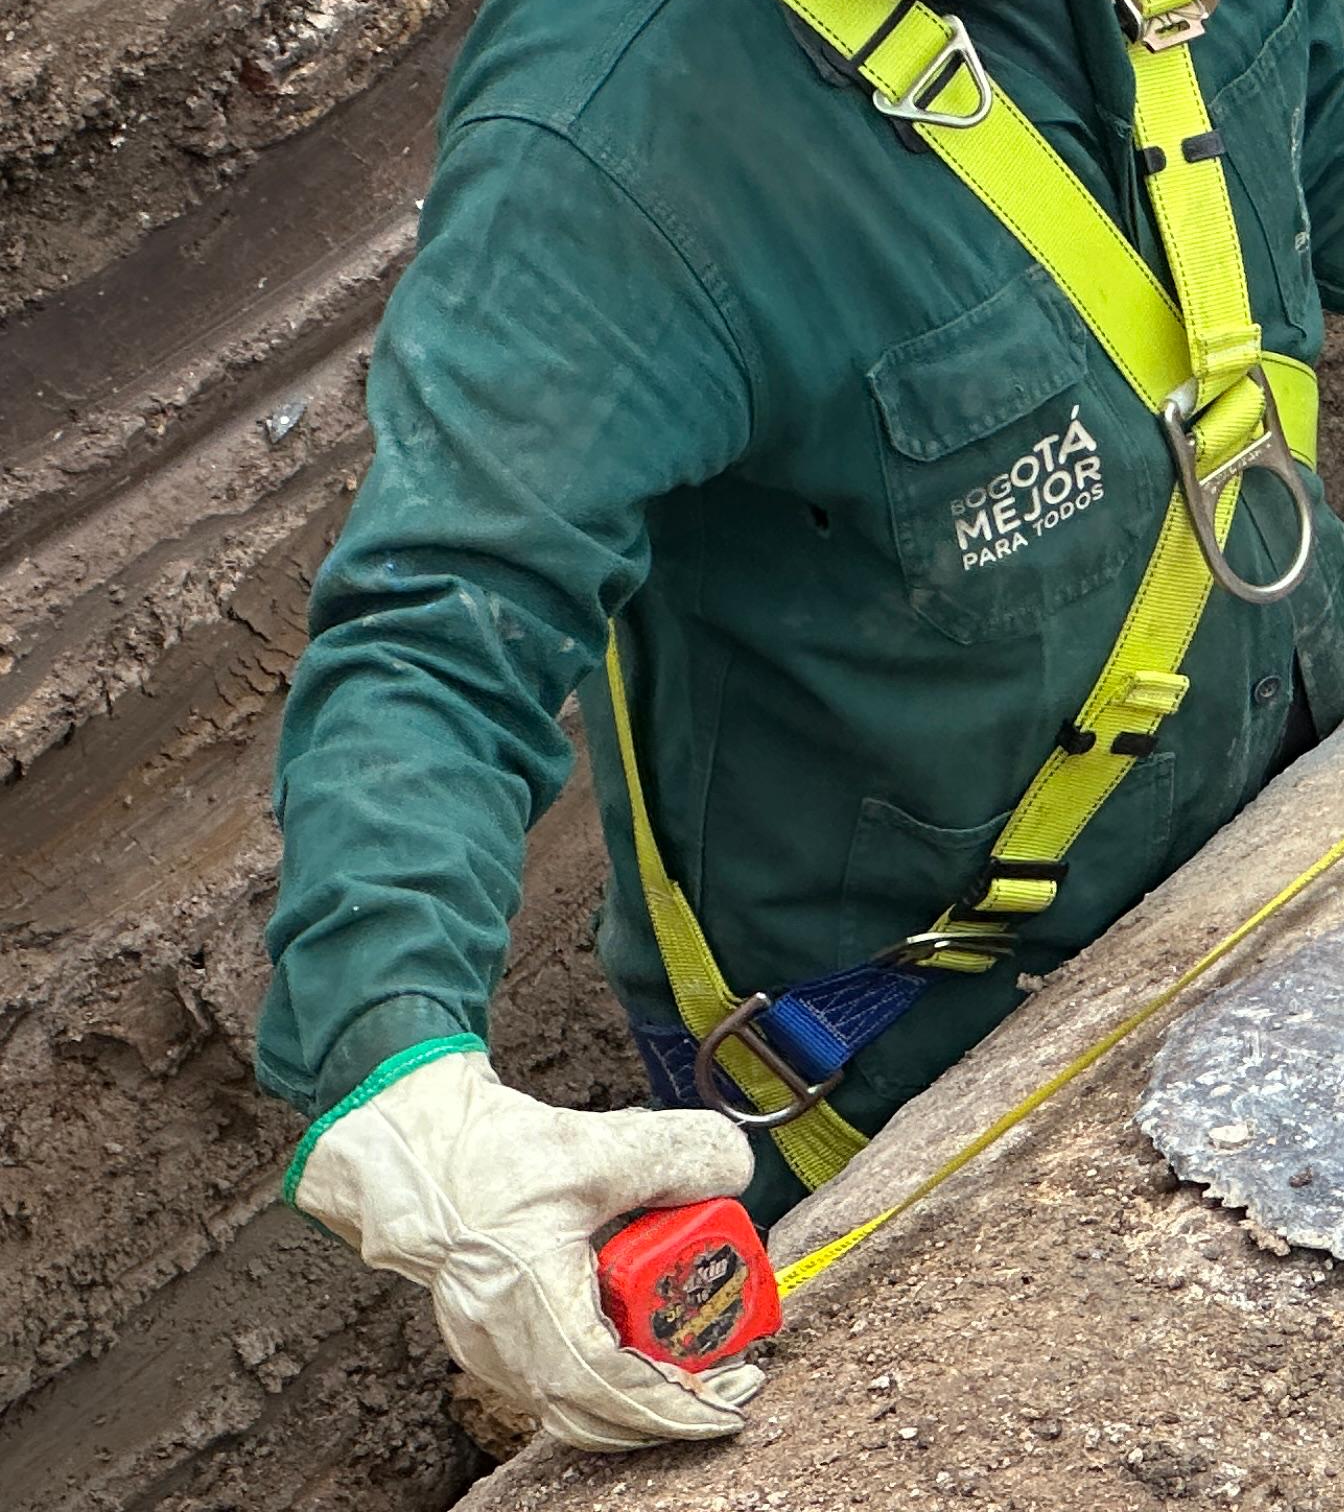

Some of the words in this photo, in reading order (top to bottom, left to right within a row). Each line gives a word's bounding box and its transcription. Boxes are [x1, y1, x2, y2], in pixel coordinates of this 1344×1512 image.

[951, 404, 1097, 516] BOGOTÁ
[954, 456, 1101, 550] MEJOR
[962, 531, 1029, 571] PARA
[1032, 483, 1105, 536] TODOS
